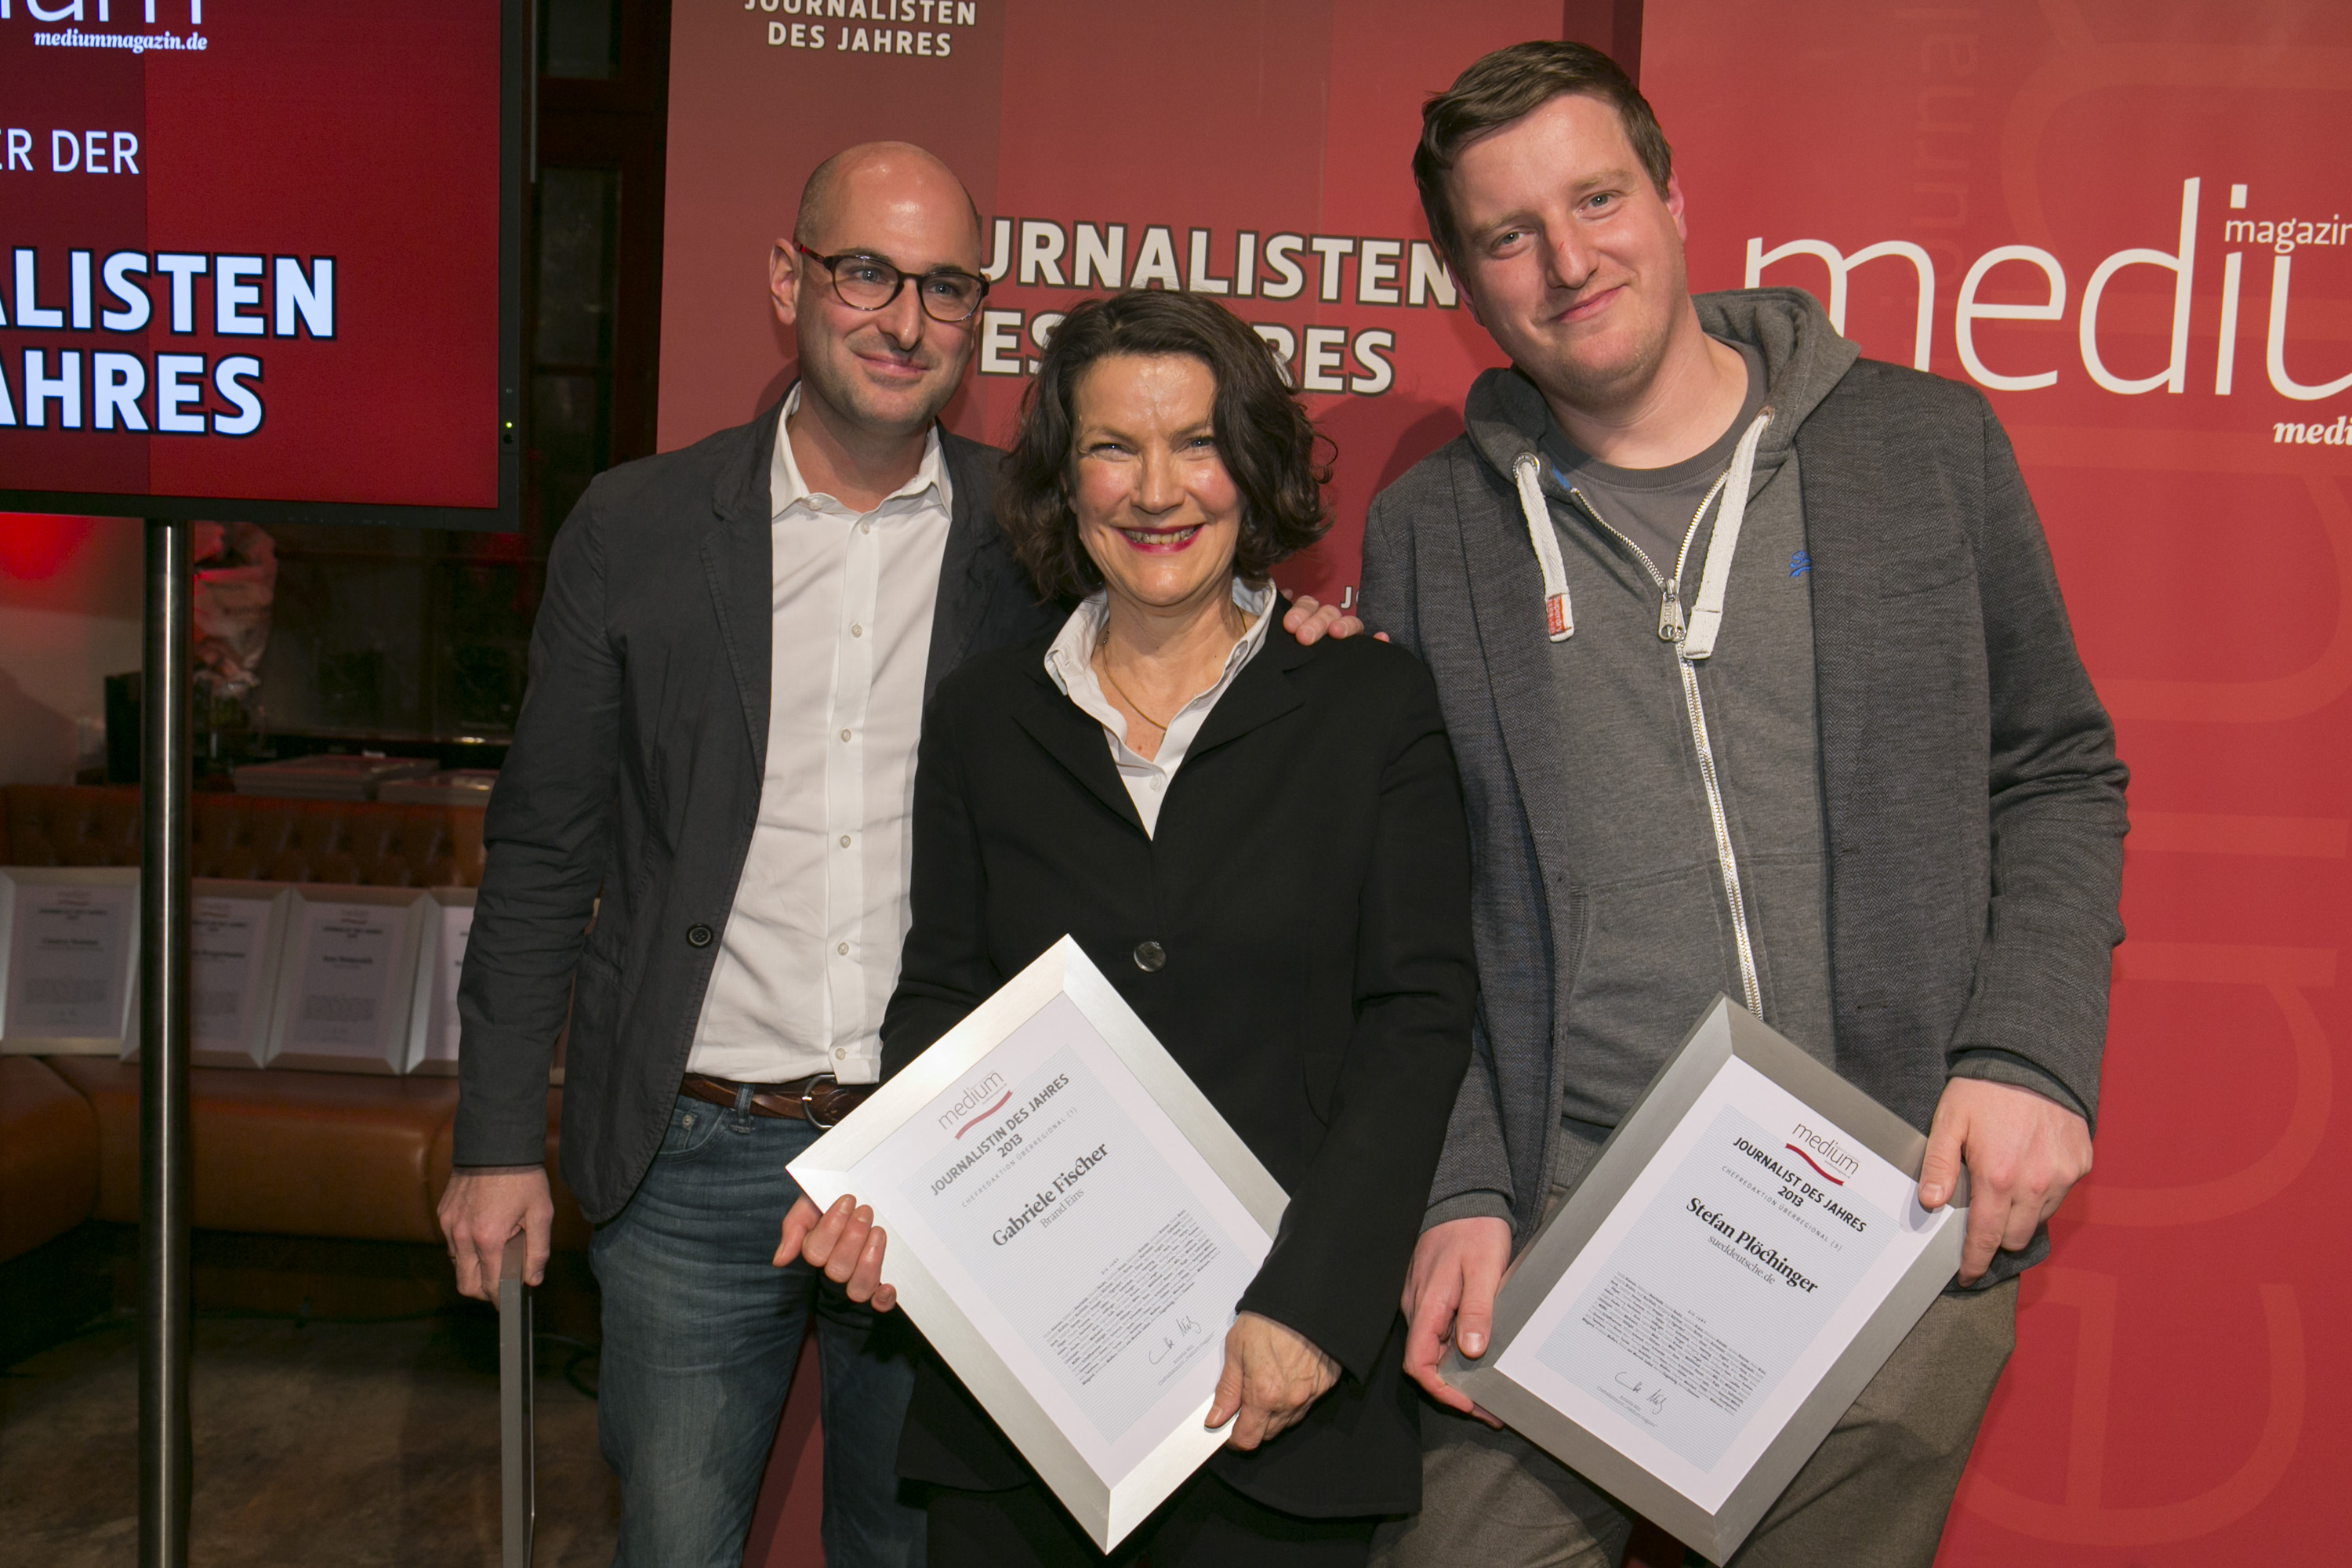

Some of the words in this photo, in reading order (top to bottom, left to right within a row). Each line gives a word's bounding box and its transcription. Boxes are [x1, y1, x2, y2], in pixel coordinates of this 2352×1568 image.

[34, 28, 208, 54] mediummagazin.de
[768, 21, 826, 49] DES
[837, 27, 952, 57] JAHRES
[51, 129, 140, 174] DER
[978, 217, 1458, 308] URNALISTEN
[0, 248, 336, 338] LISTEN
[1252, 324, 1393, 395] RES
[938, 1071, 1004, 1131] medium
[931, 1127, 1007, 1196] JOURNALISTIN
[1005, 1107, 1029, 1131] DES
[1029, 1073, 1069, 1112] JAHRES
[997, 1134, 1023, 1158] 2013
[1792, 1123, 1860, 1176] medium
[962, 1160, 1016, 1208] CHEFREDAKTION
[993, 1190, 1056, 1247] Gabriele
[1052, 1143, 1109, 1195] Fischer
[1040, 1201, 1068, 1229] Brand
[1065, 1189, 1084, 1208] Eins
[1722, 1165, 1777, 1207] CHEFREDAKTION
[1778, 1204, 1828, 1243] ÜBERREGIONAL
[1733, 1137, 1802, 1188] JOURNALIST
[1800, 1182, 1825, 1204] DES
[1823, 1199, 1867, 1233] JAHRES
[1777, 1185, 1805, 1207] 2013
[1686, 1197, 1736, 1239] Stefan
[1735, 1230, 1819, 1294] Plöchinger
[1708, 1235, 1776, 1285] sueddeutsche.de
